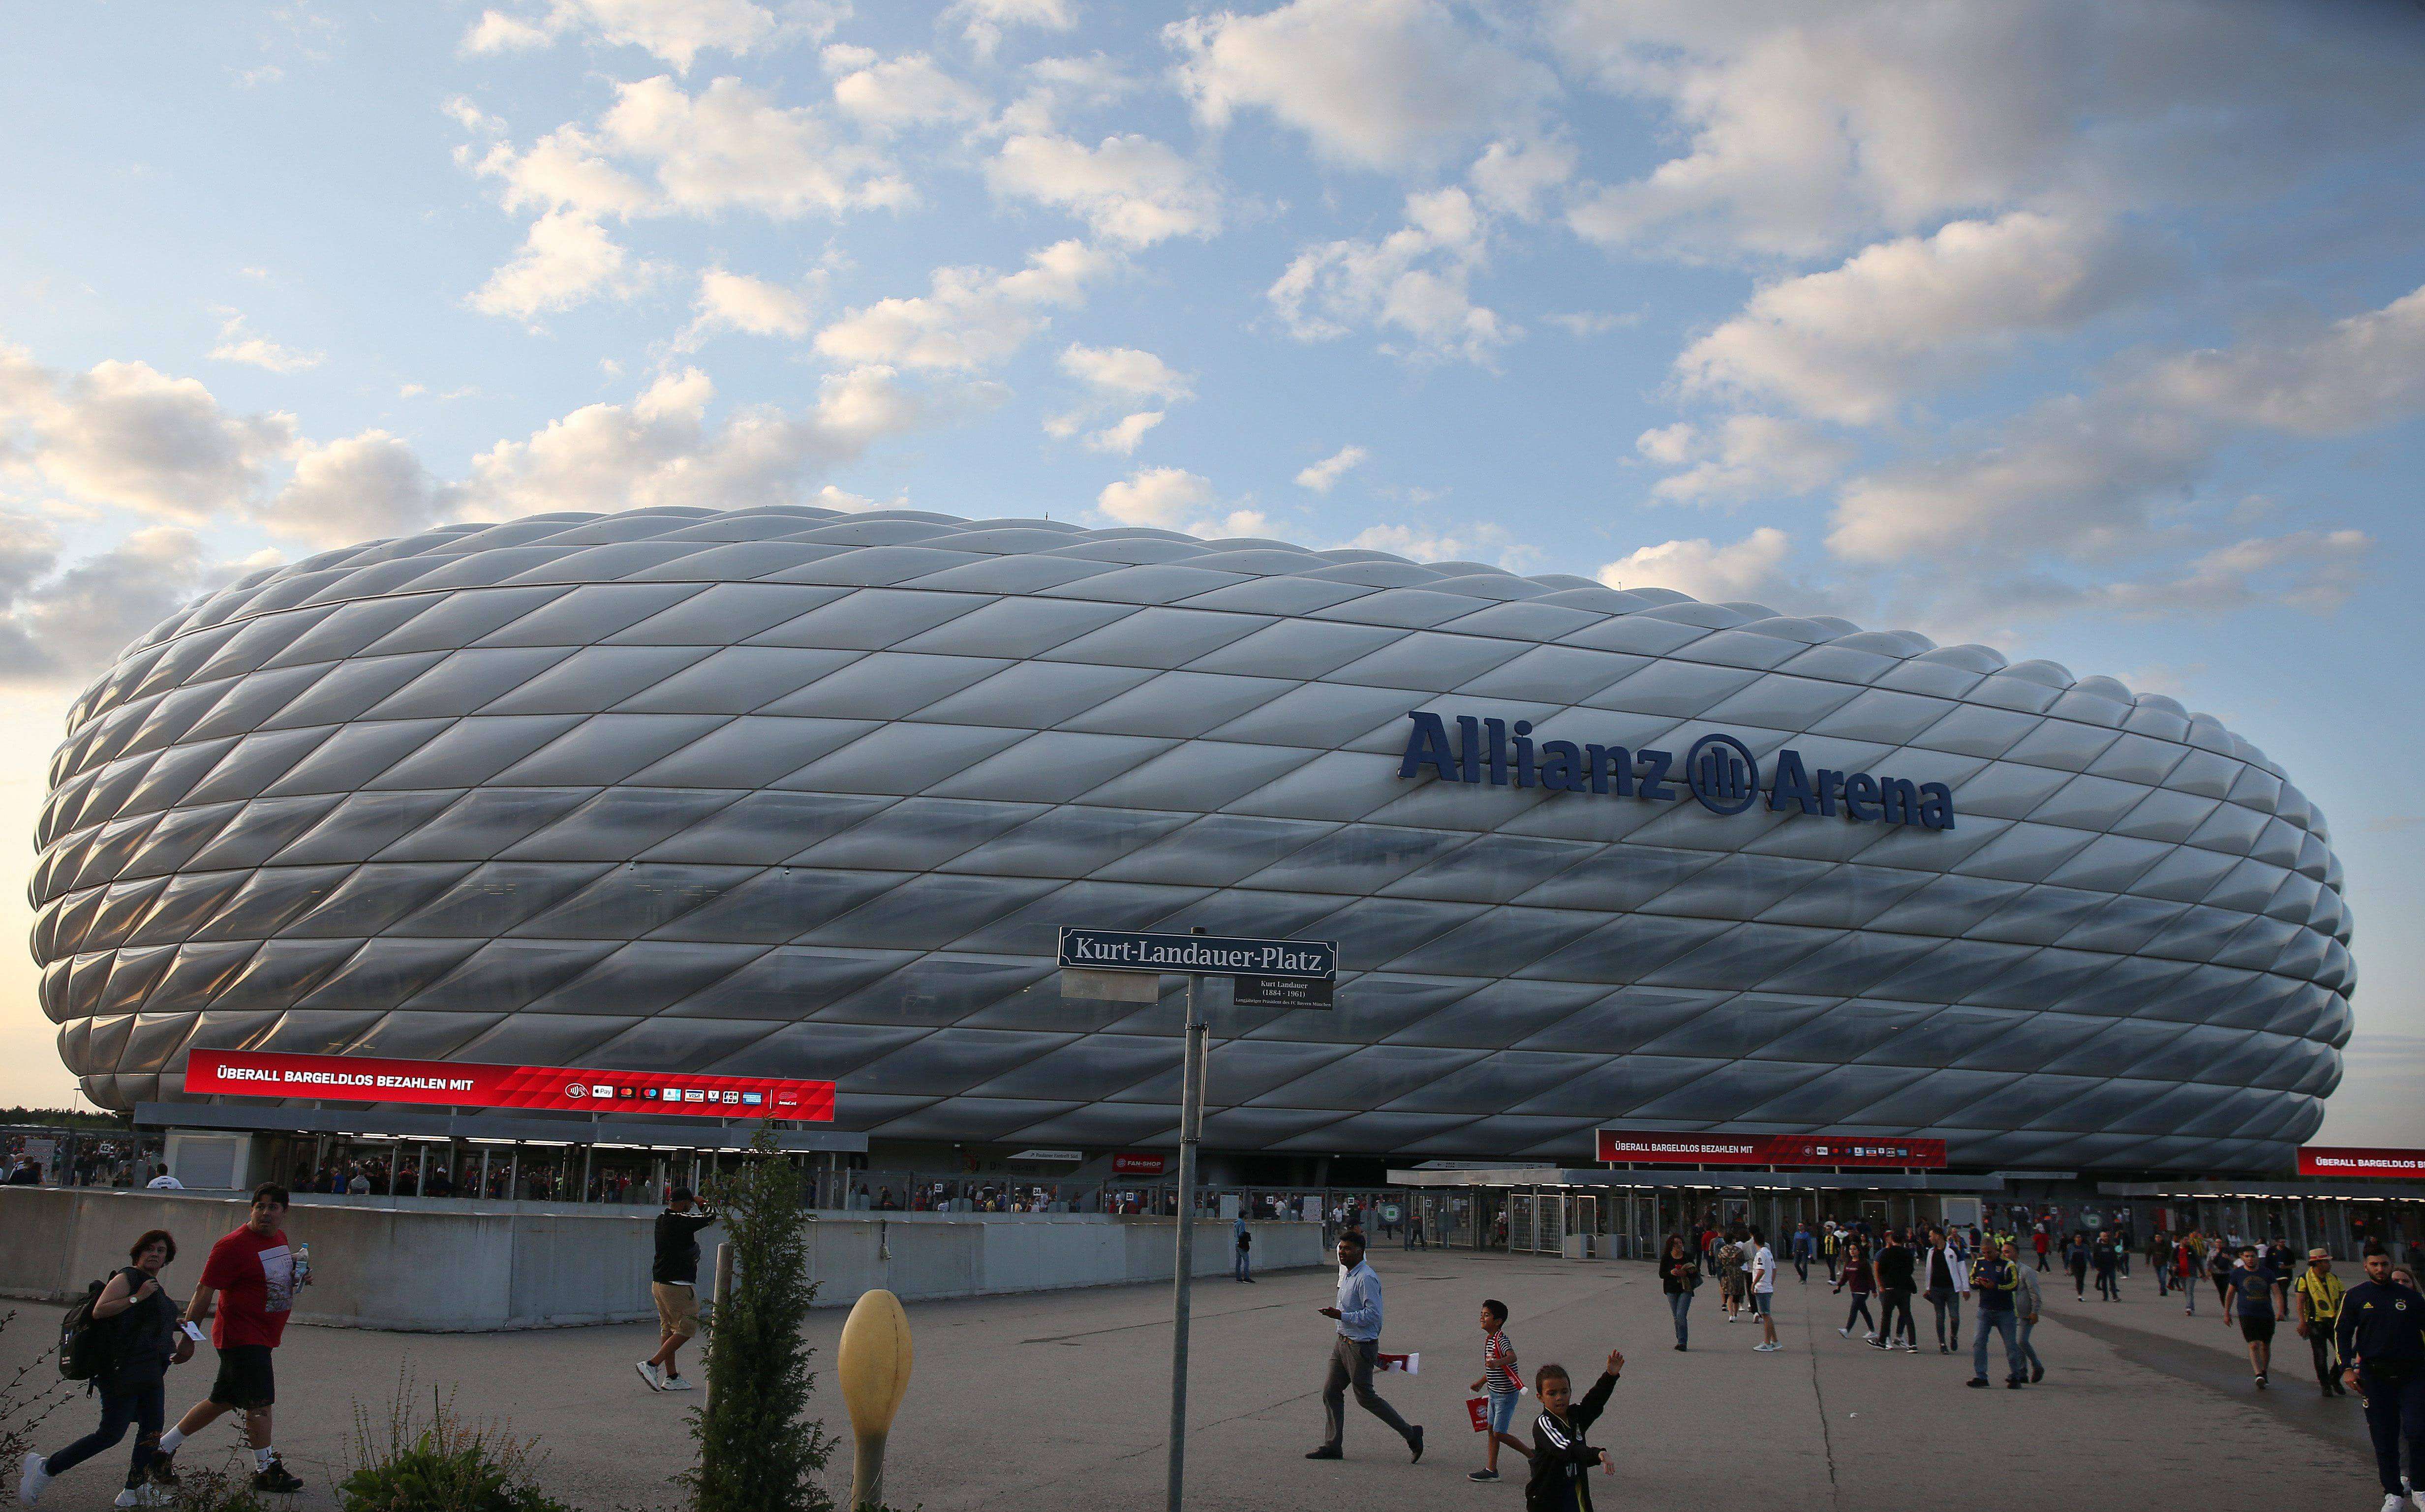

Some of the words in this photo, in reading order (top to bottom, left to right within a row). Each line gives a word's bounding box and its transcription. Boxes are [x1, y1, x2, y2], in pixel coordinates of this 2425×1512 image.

[1399, 710, 1677, 801] Allianz
[1770, 749, 1956, 830] Arena
[1075, 937, 1322, 971] Kurt-Landauer-Platz
[217, 1064, 280, 1082] ÜBERALL
[284, 1071, 373, 1086] BARGELDLOS
[377, 1076, 446, 1089] BEZAHLEN
[450, 1079, 473, 1091] MIT
[1615, 1141, 1650, 1151] ÜBERALL
[1651, 1143, 1700, 1153] BARGELDLOS
[1701, 1145, 1739, 1153] BEZAHLEN
[2315, 1157, 2356, 1167] ÜBERALL
[2357, 1159, 2416, 1168] BARGELDLOS
